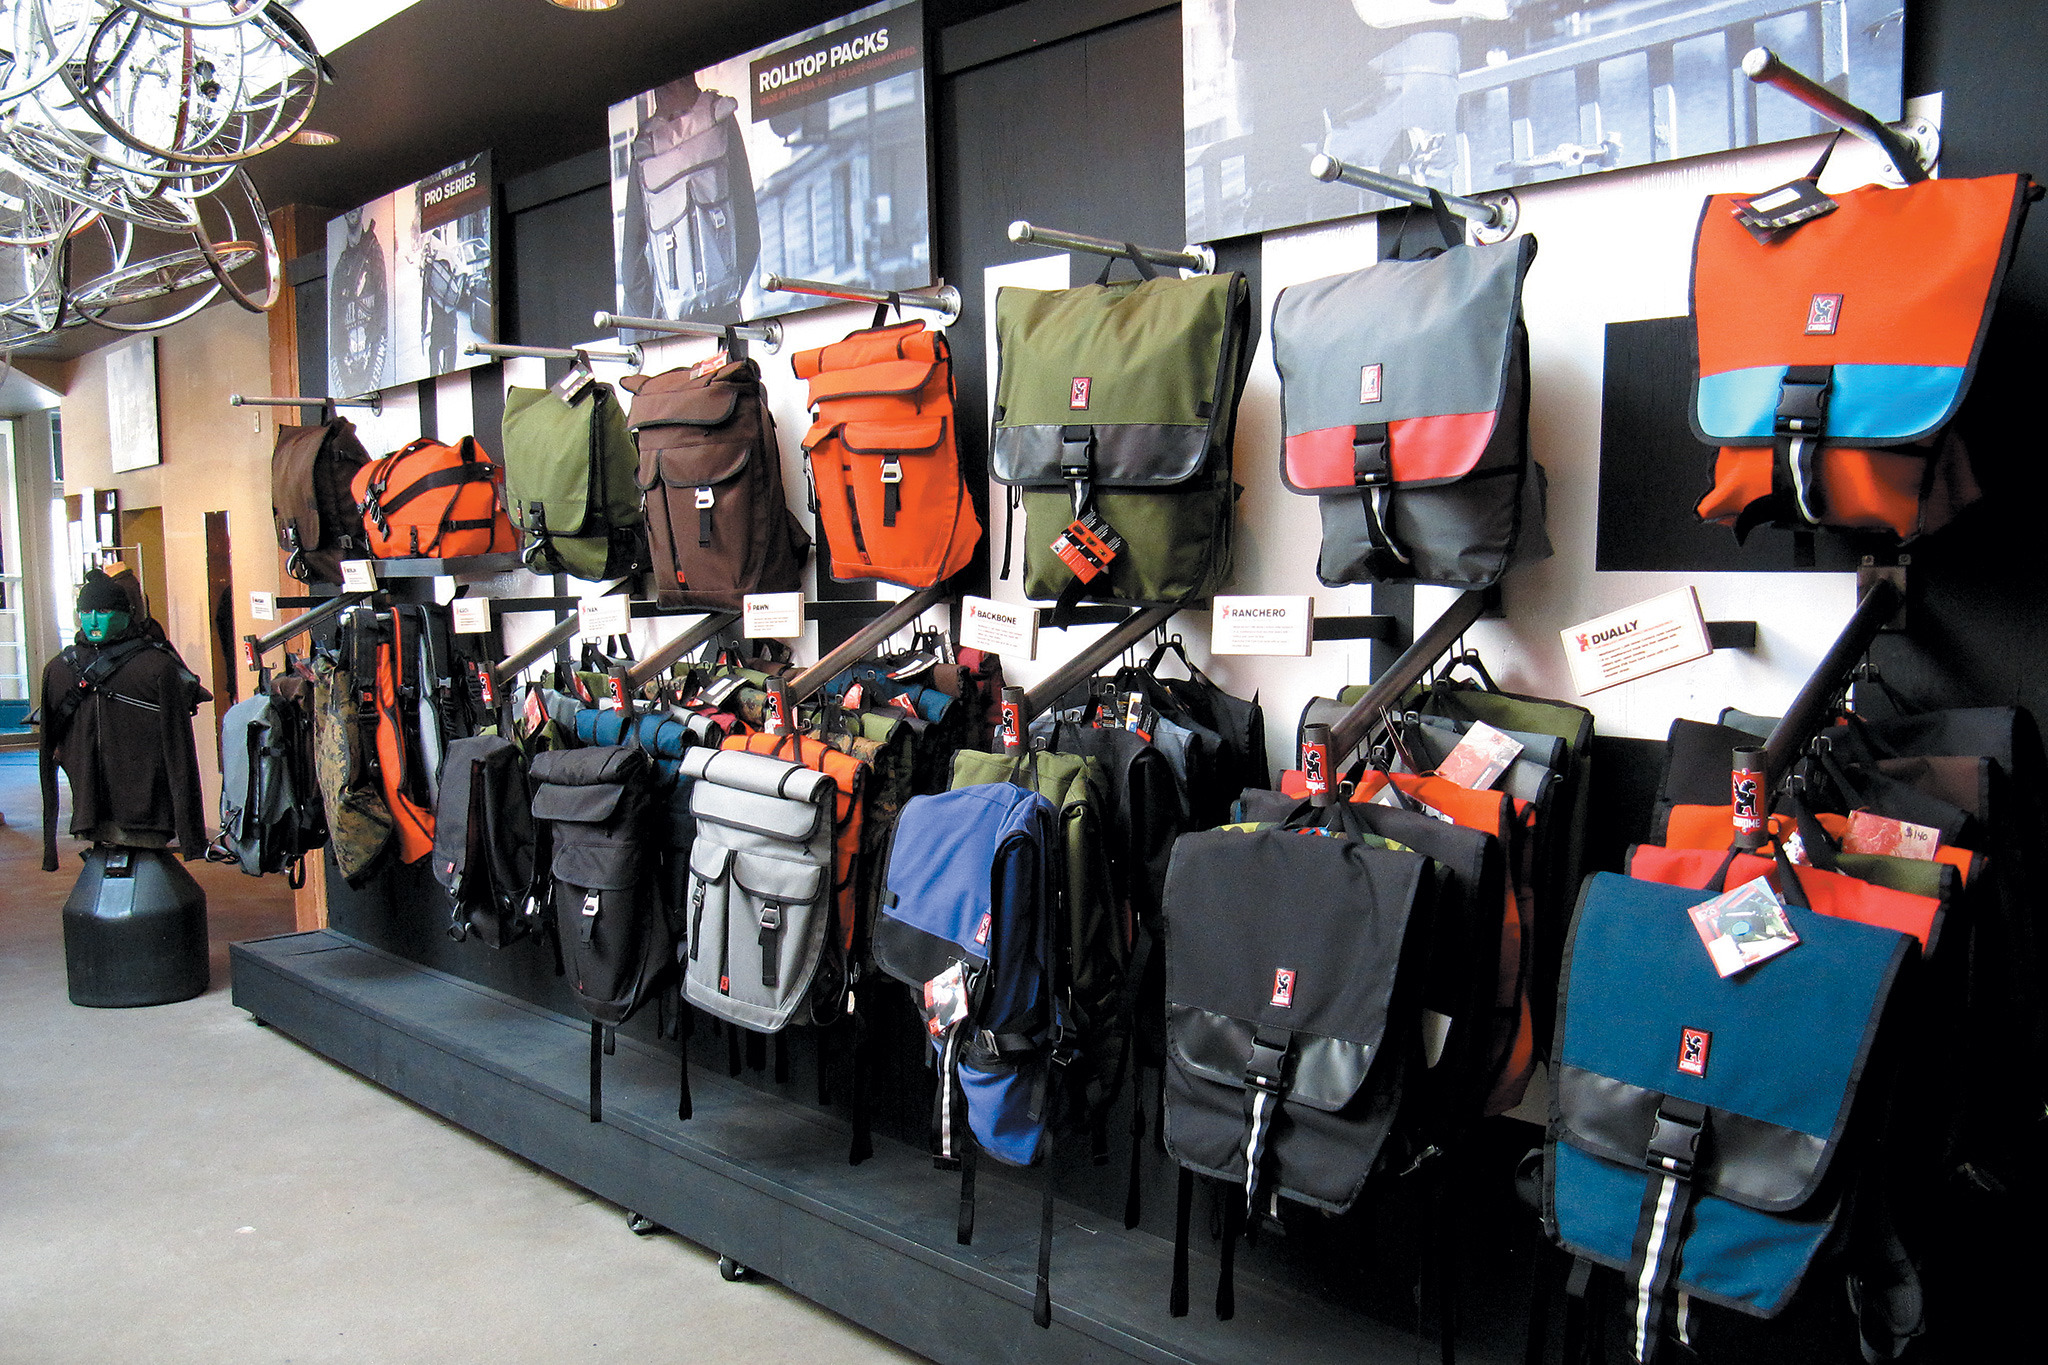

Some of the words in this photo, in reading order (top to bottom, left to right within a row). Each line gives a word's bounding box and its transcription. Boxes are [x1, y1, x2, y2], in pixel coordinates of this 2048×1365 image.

[759, 51, 828, 93] ROLLTOP
[830, 28, 889, 68] PACKS
[424, 187, 443, 208] PRO
[443, 171, 477, 199] SERIES
[977, 609, 1017, 625] BACKBONE
[1231, 608, 1286, 618] RANCHERO
[1591, 619, 1639, 645] DUALLY
[1732, 815, 1760, 829] CHROME
[1905, 826, 1928, 841] $140
